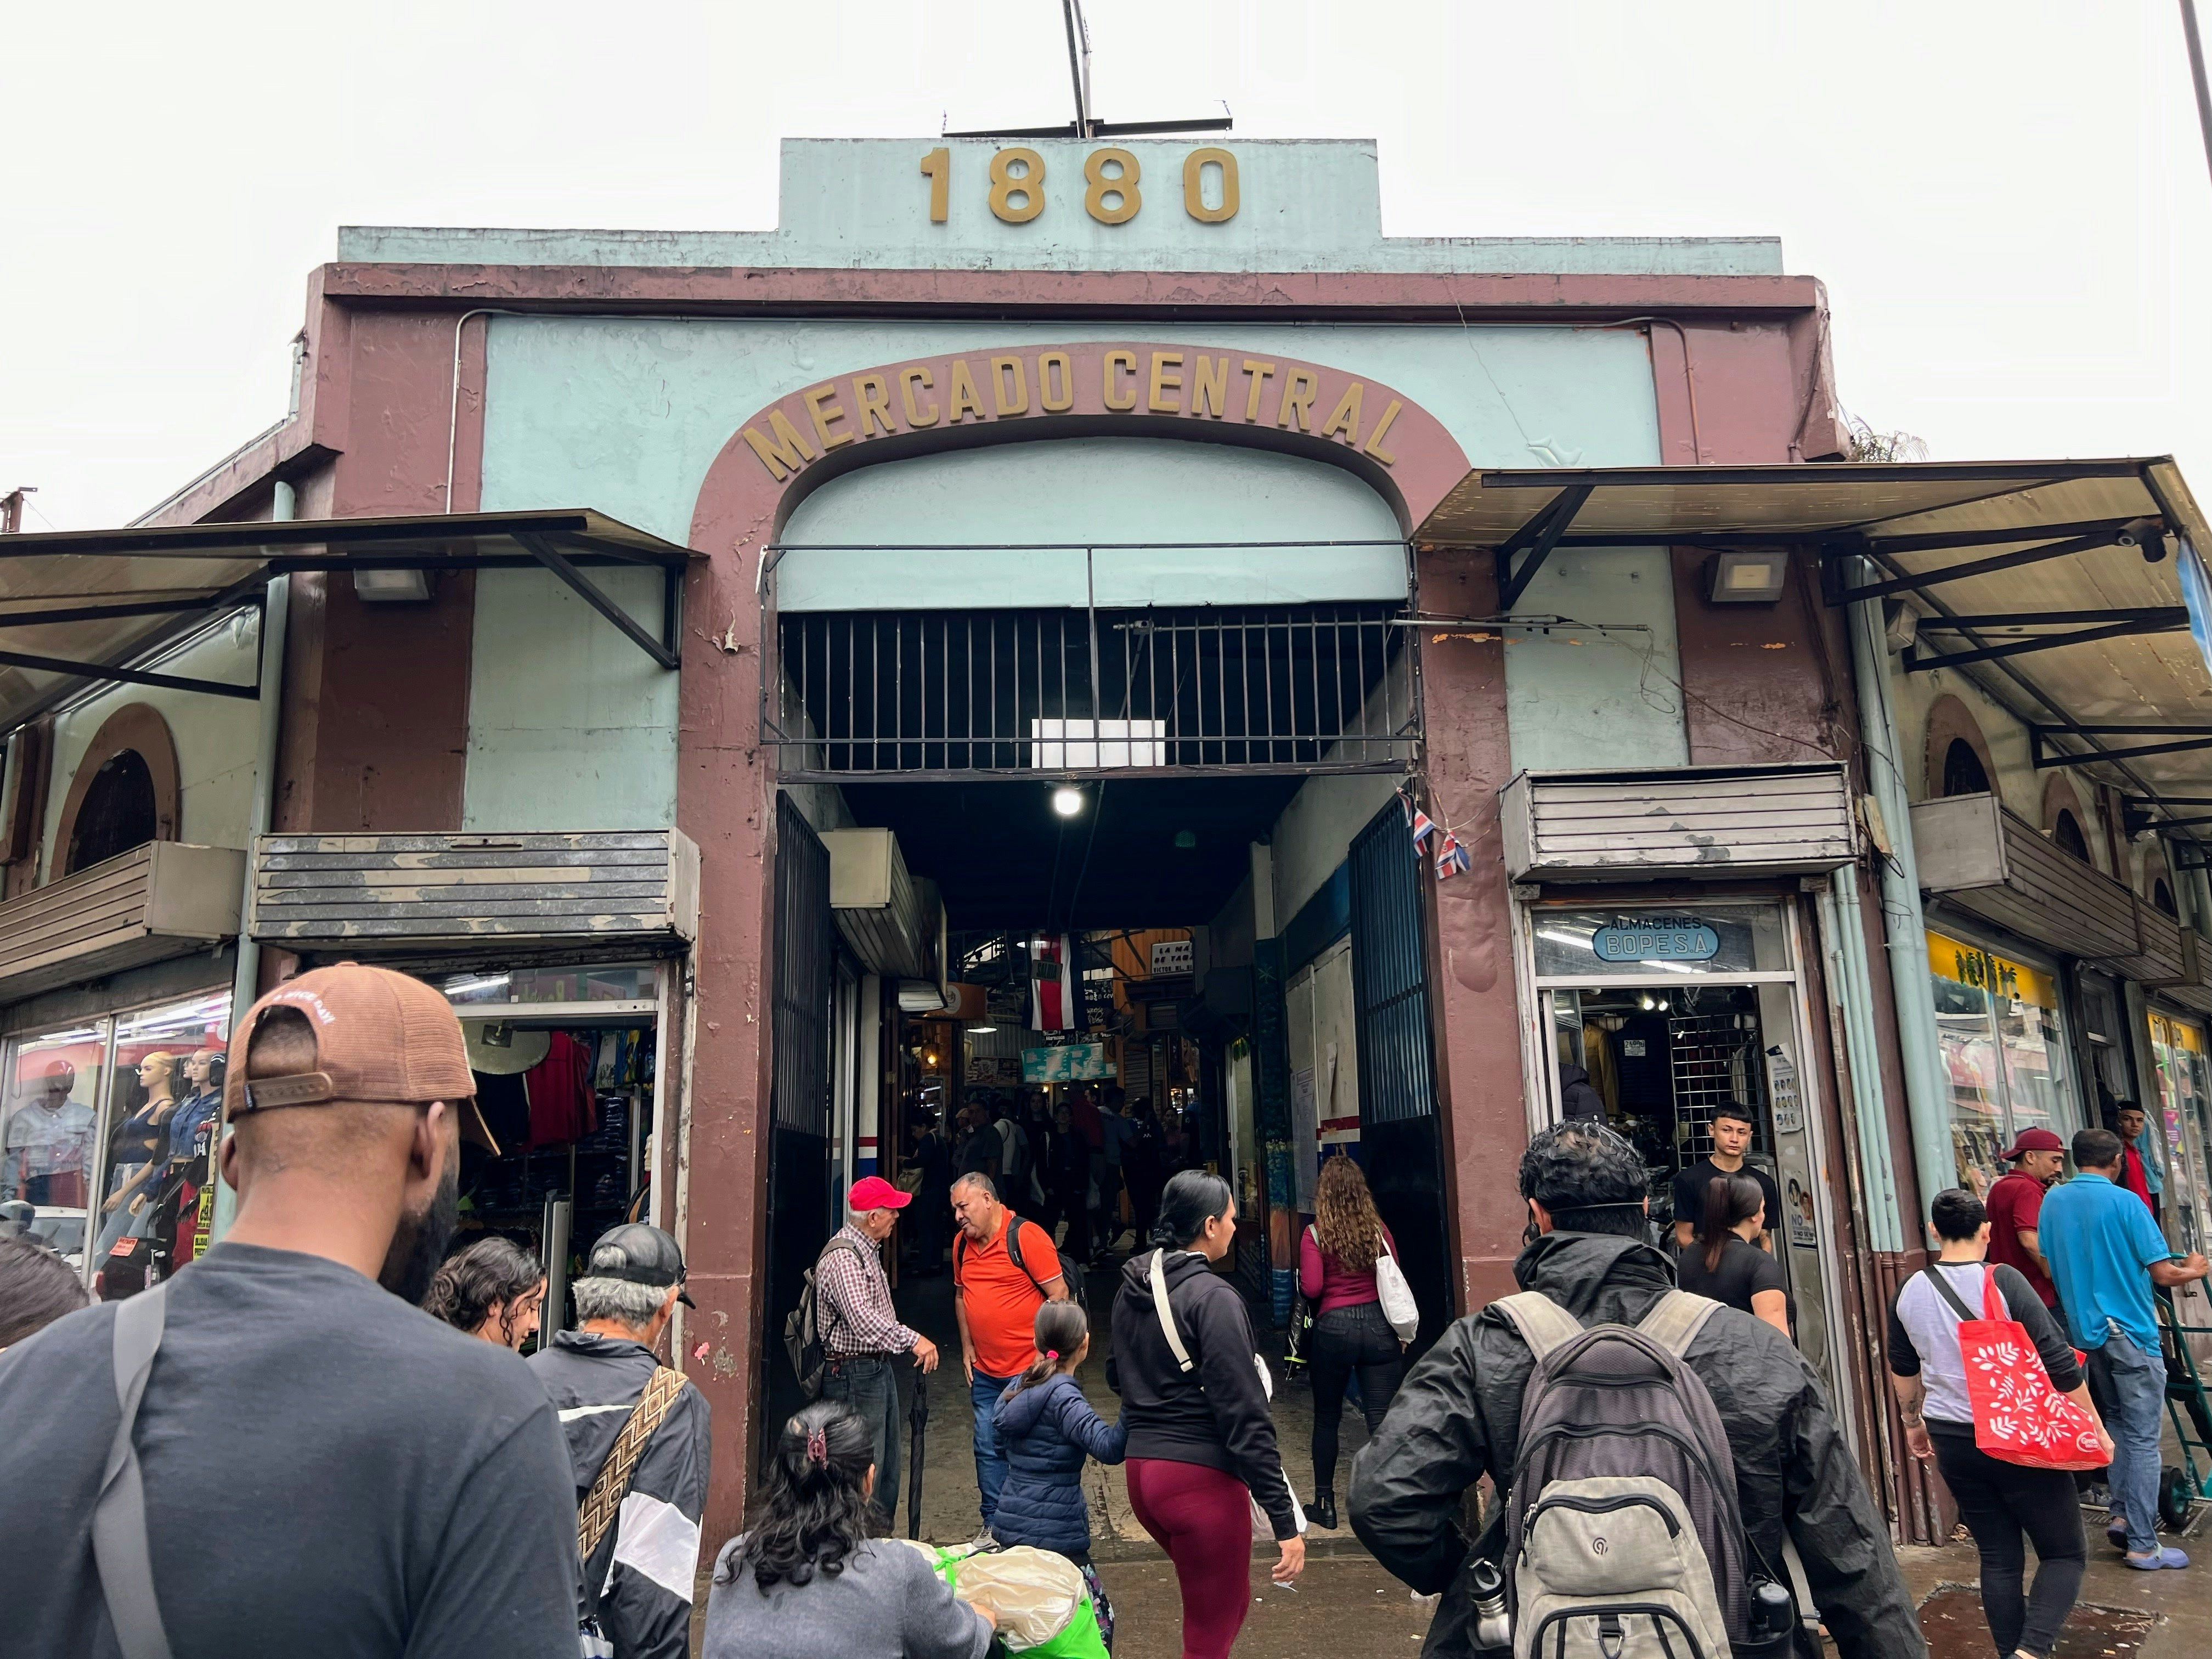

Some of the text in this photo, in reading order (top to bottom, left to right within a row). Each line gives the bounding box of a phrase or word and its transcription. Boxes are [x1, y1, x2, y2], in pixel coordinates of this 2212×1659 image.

[919, 147, 1241, 223] 1880
[743, 349, 1404, 482] MERCADO CENTRAL
[1610, 917, 1701, 930] ALMACENES
[1791, 1214, 1803, 1226] NO
